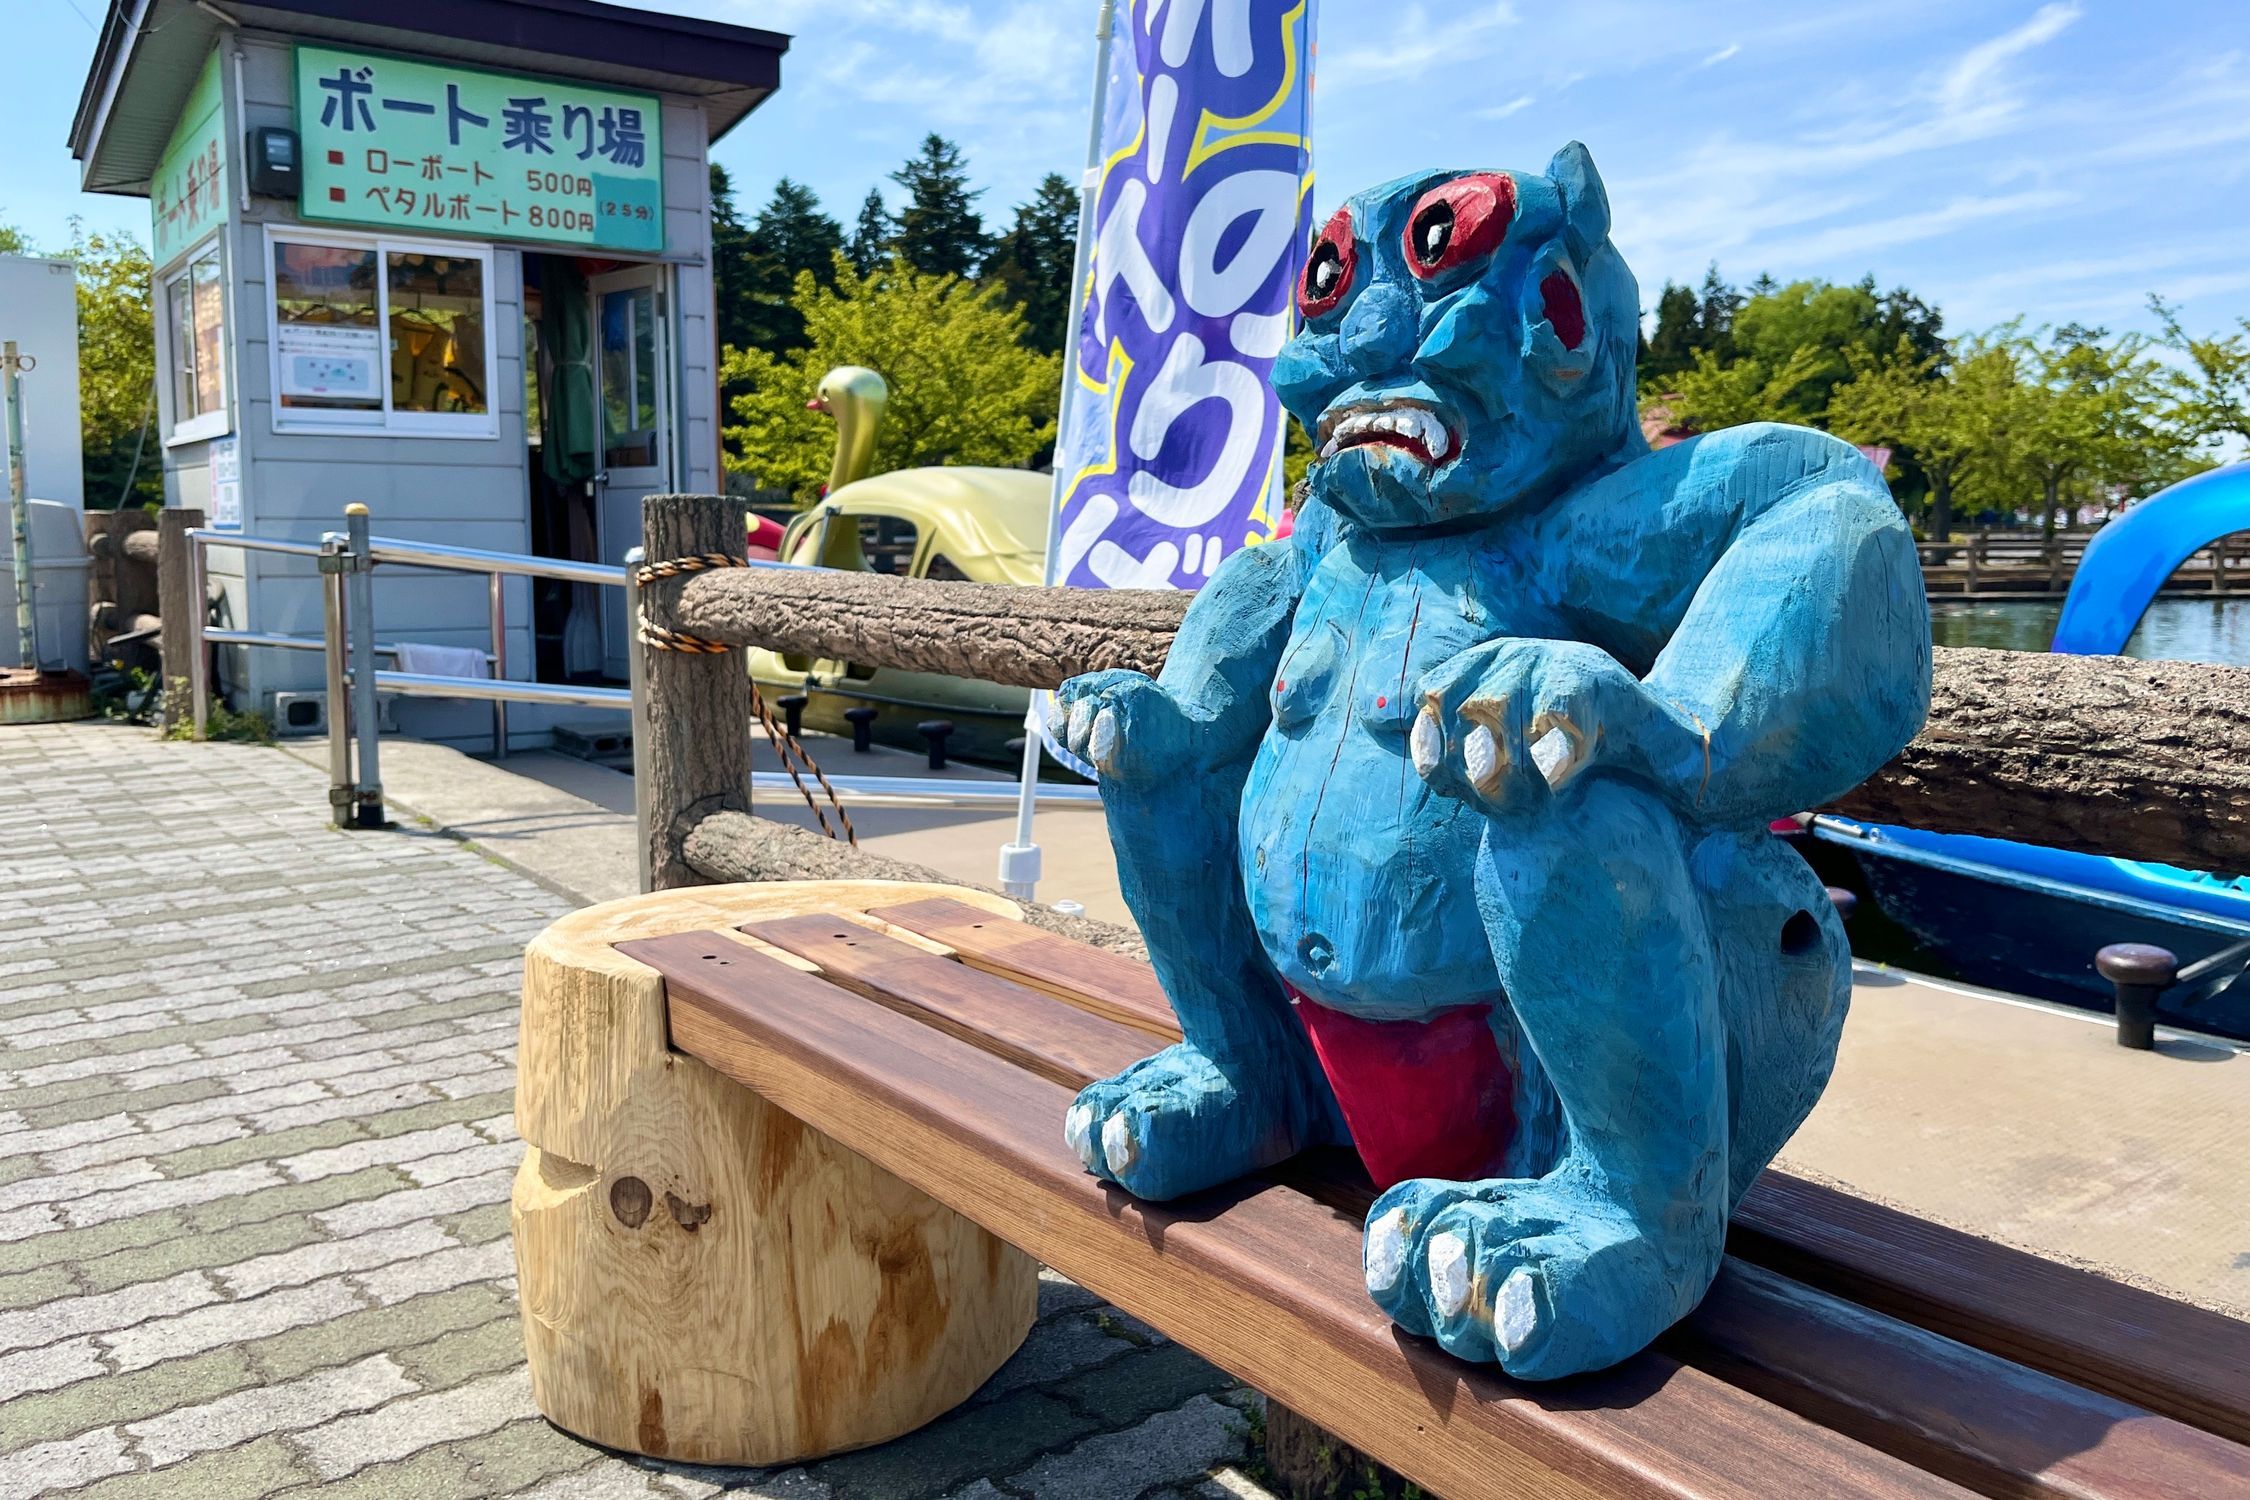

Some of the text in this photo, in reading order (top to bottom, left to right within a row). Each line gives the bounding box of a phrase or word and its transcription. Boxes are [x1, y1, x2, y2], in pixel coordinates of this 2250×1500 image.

[318, 67, 646, 168] ボート乗り場
[366, 149, 593, 198] ローボート 500円
[528, 205, 594, 231] 800円
